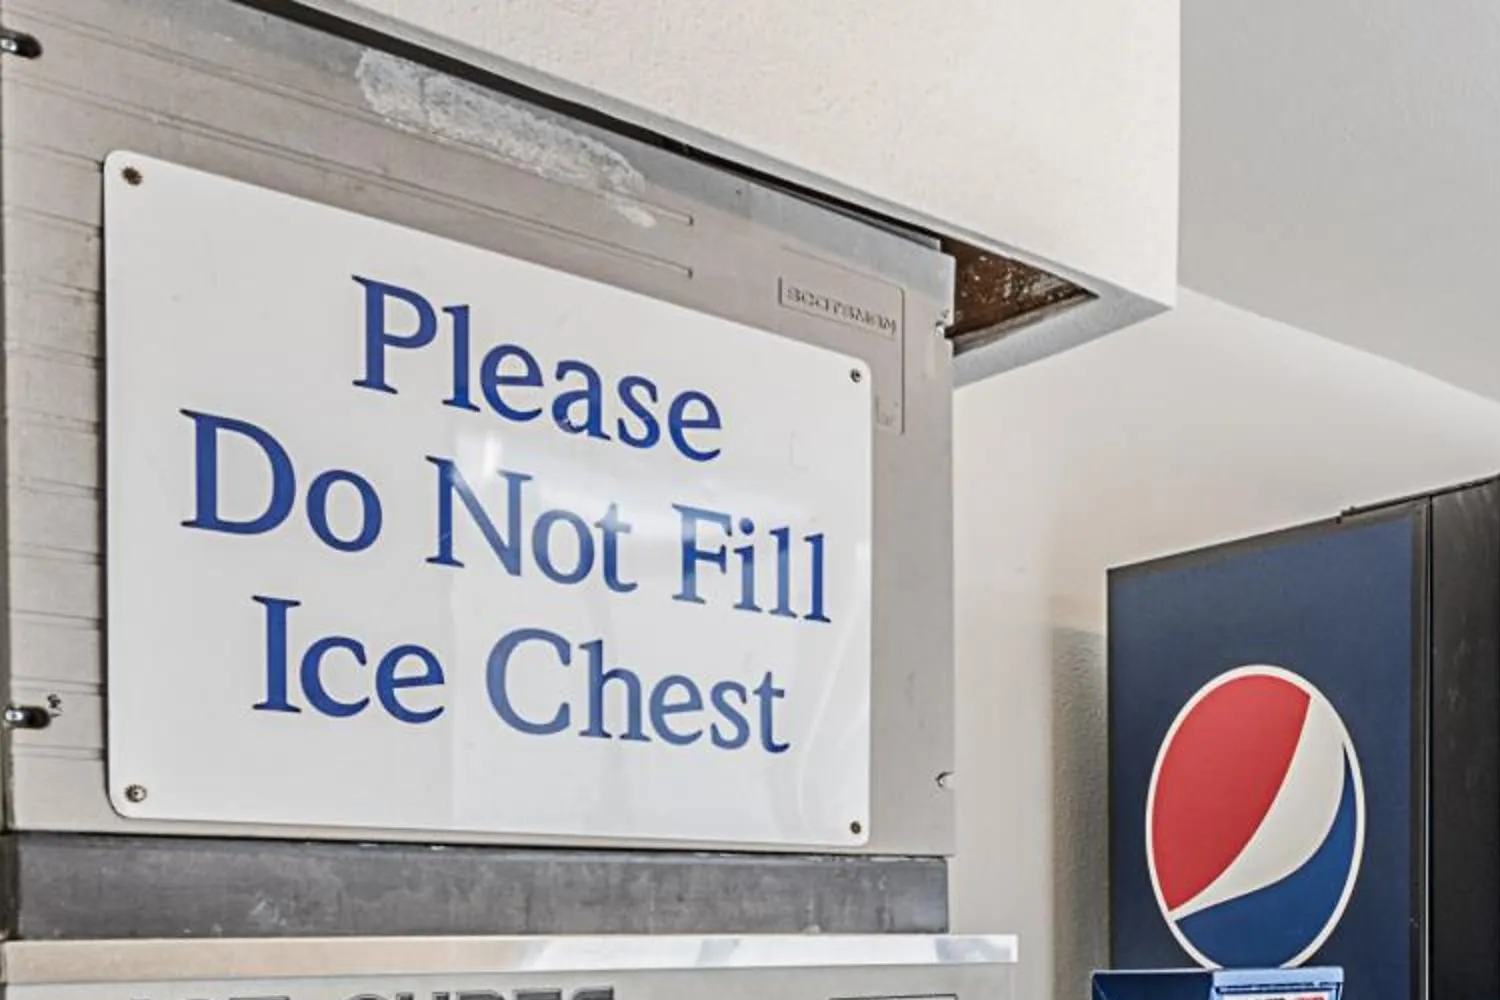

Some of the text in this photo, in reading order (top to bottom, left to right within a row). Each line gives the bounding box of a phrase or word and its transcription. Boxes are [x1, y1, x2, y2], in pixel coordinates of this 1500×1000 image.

[352, 275, 723, 461] Please
[180, 408, 832, 624] Do Not Fill
[252, 596, 790, 754] Ice Chest
